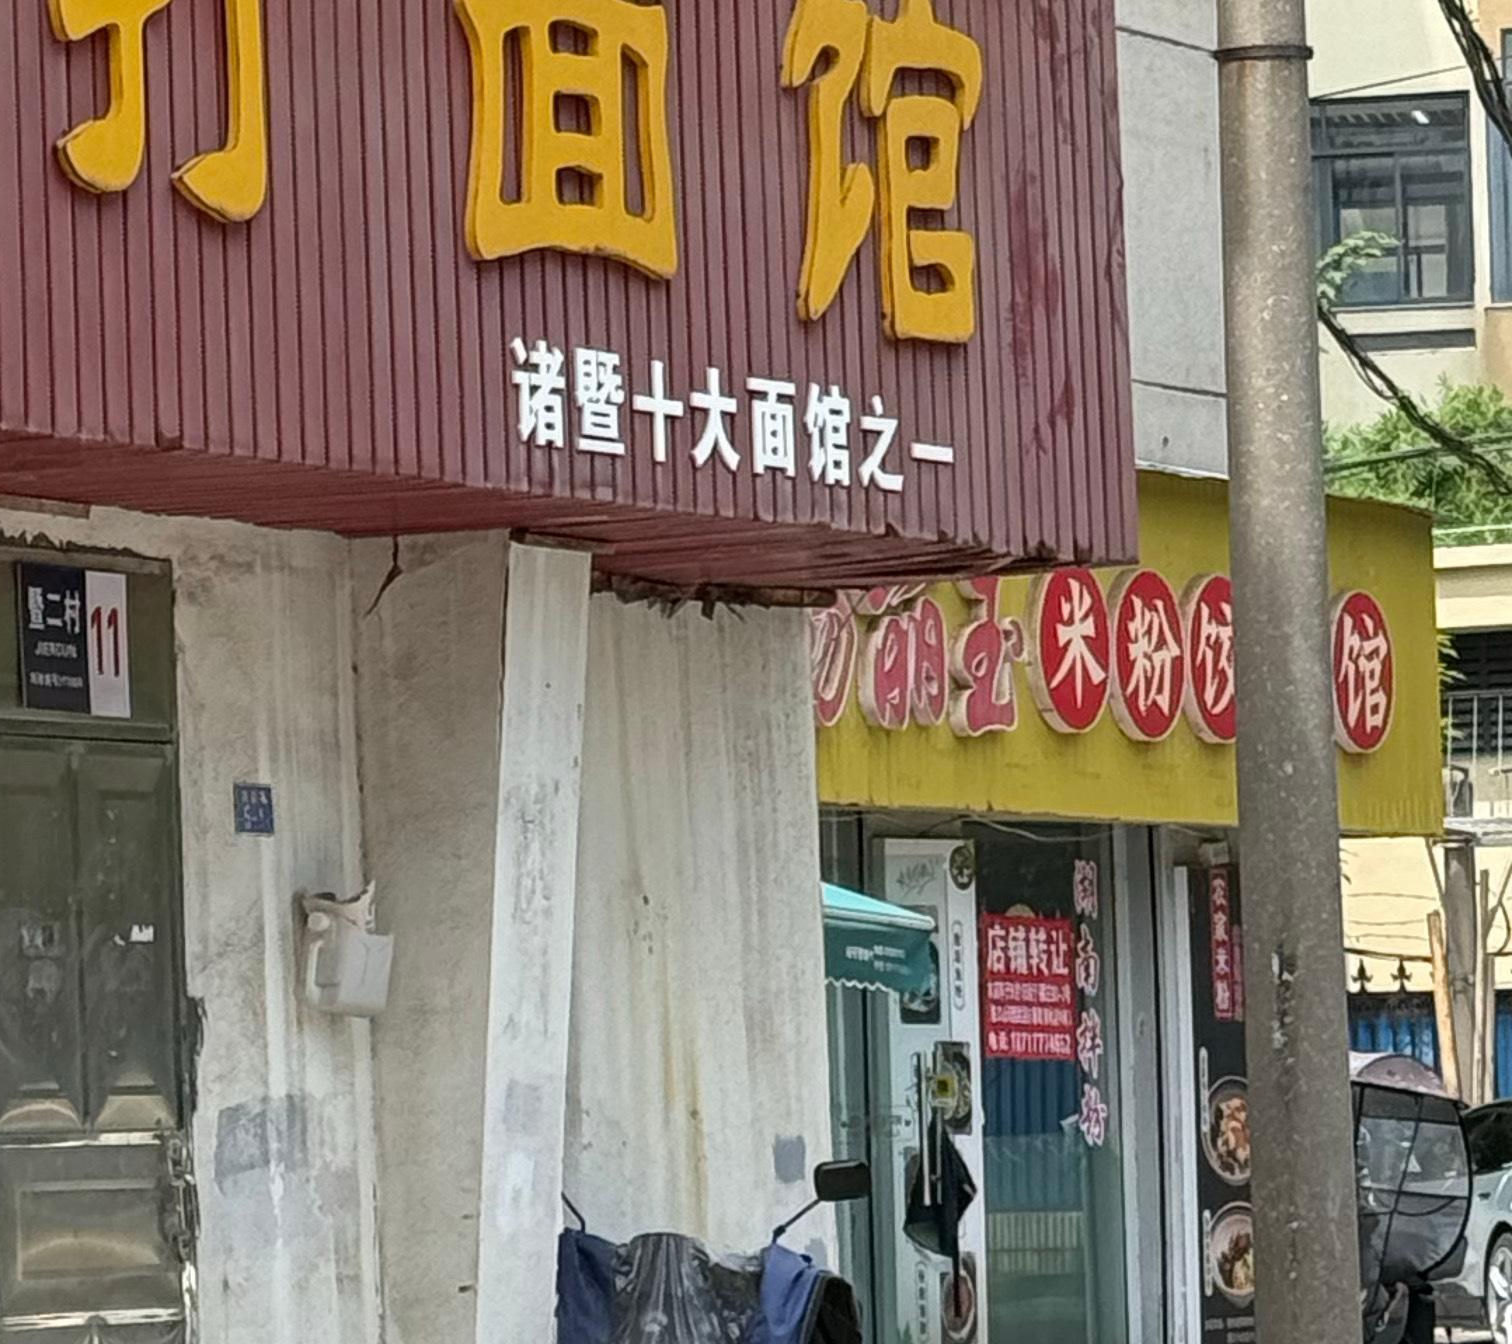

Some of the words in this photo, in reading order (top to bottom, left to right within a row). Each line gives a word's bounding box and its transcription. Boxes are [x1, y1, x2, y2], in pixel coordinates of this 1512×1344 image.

[510, 336, 955, 493] 诸暨十大面馆之一
[91, 606, 120, 677] 11
[987, 923, 1070, 977] 店铺转让
